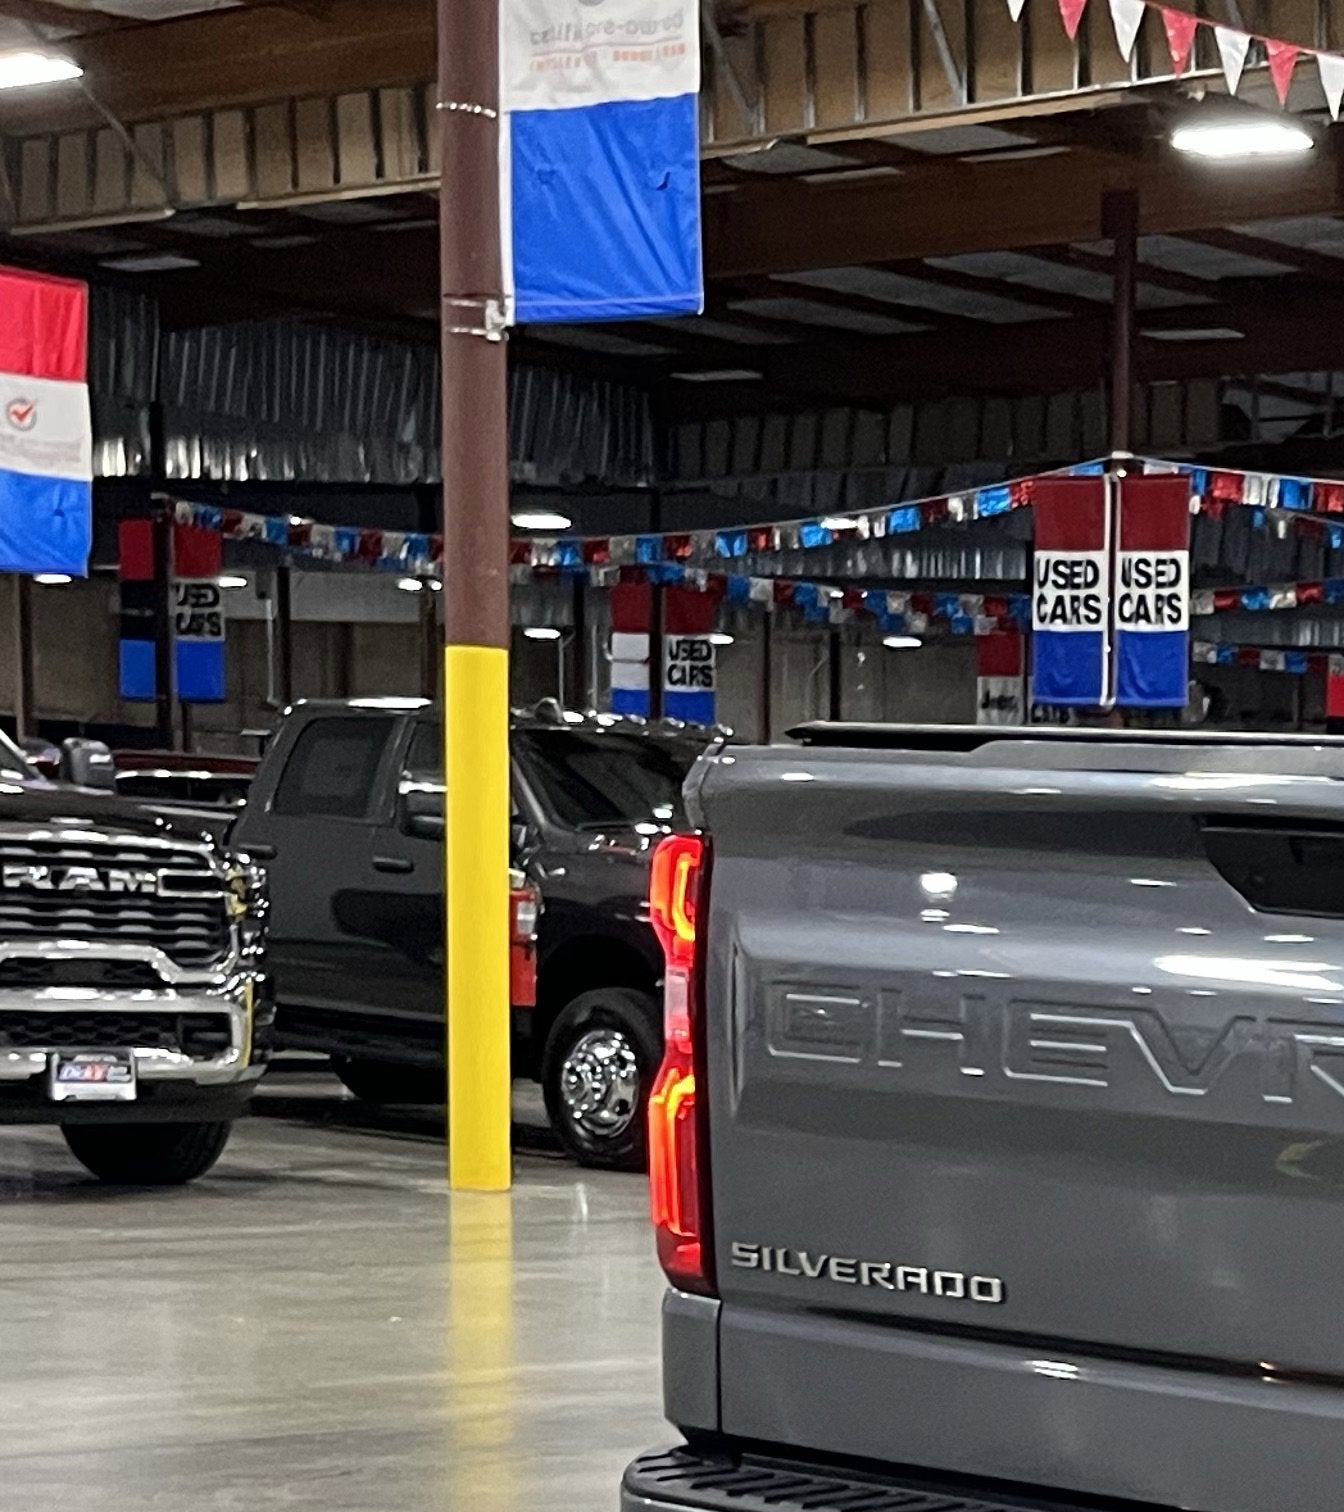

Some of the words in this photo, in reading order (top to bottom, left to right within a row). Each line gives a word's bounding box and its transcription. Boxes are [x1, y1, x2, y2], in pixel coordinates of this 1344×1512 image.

[1037, 558, 1099, 590] USED
[1121, 558, 1181, 589] USED
[1036, 593, 1102, 625] CARS
[1118, 593, 1182, 624] CARS
[3, 865, 157, 893] RAM
[732, 1242, 1002, 1303] SILVERADO
